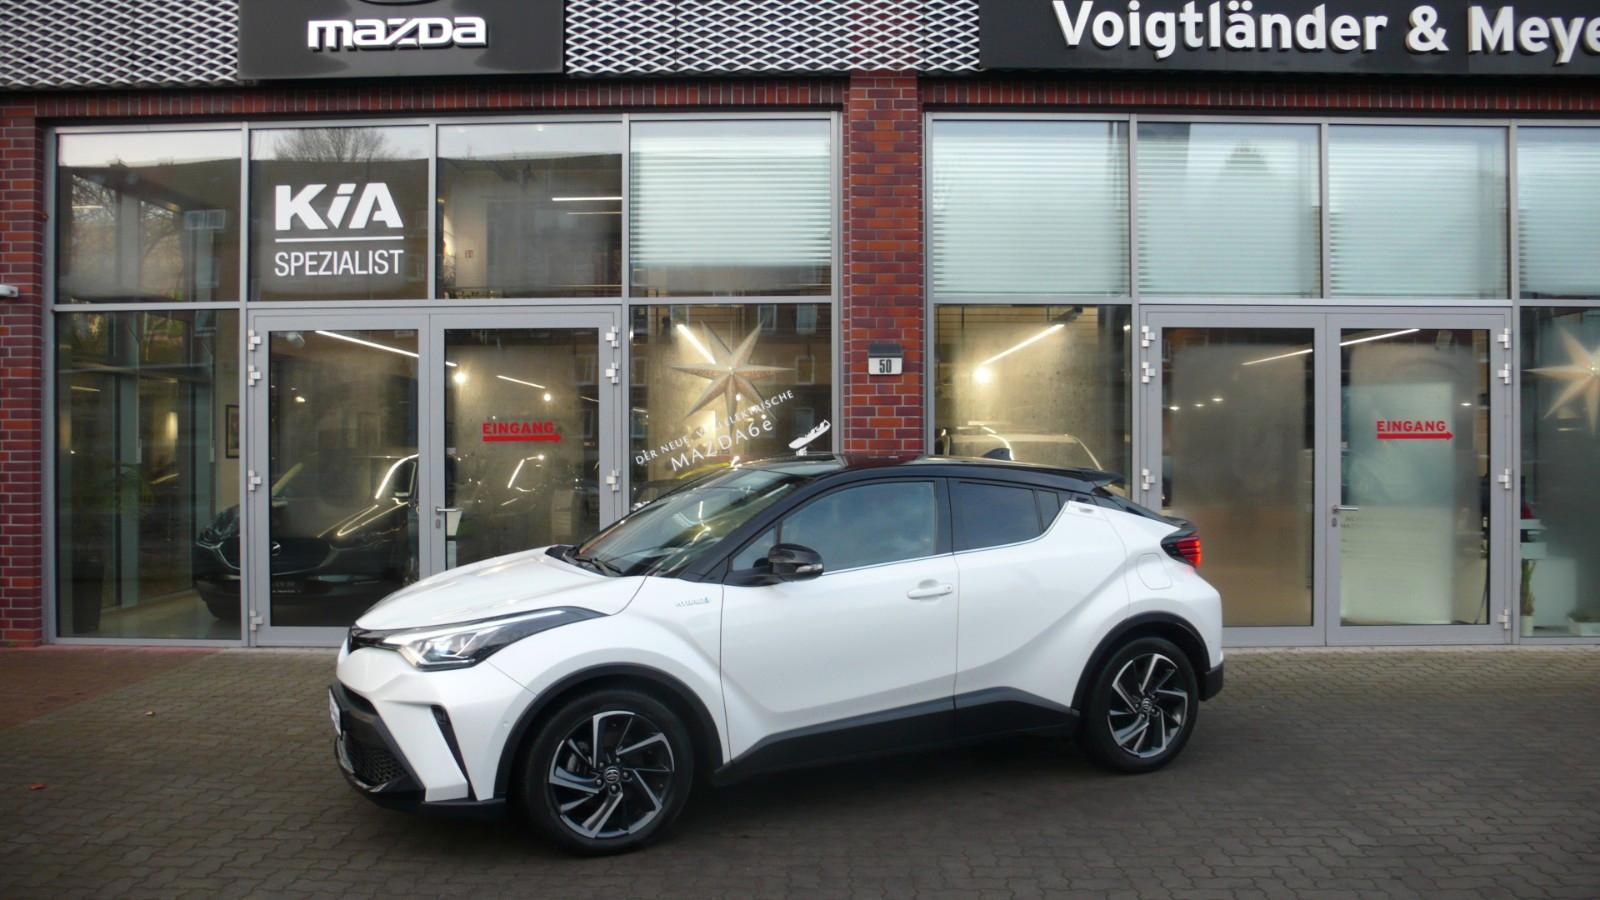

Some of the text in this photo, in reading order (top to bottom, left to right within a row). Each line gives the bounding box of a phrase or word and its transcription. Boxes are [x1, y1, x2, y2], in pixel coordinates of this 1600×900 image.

[1052, 0, 1389, 59] Voigtländer
[1405, 5, 1449, 52] &
[274, 249, 404, 277] SPEZIALIST
[879, 359, 892, 373] 50
[482, 421, 553, 434] EINGANG
[1376, 420, 1446, 432] EINGANG
[670, 418, 774, 472] MAZDA6e
[635, 450, 658, 466] DER
